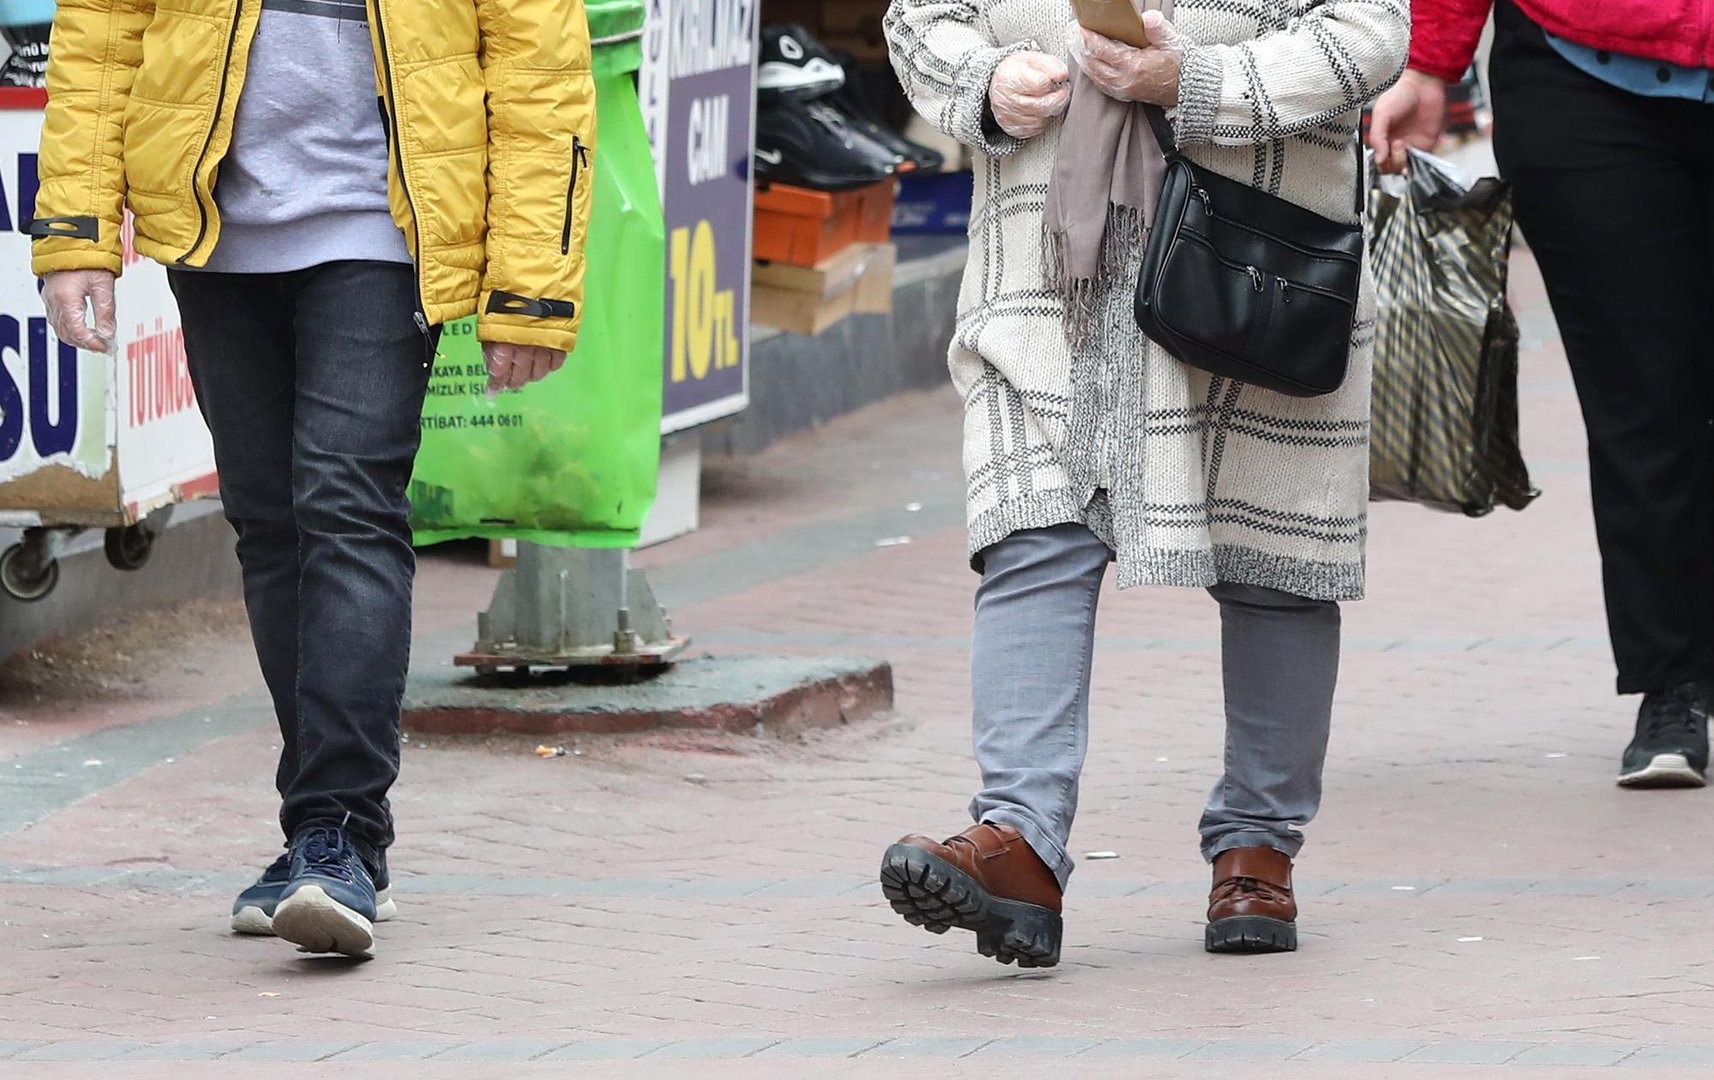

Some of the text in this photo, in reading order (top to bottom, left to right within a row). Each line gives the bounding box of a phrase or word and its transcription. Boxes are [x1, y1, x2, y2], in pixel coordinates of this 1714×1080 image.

[687, 93, 729, 186] CAM
[443, 323, 472, 336] LED
[432, 364, 487, 379] KAYA BEL
[428, 383, 465, 397] MİZLİK
[420, 415, 467, 430] RTİBAT:
[471, 416, 495, 427] 444
